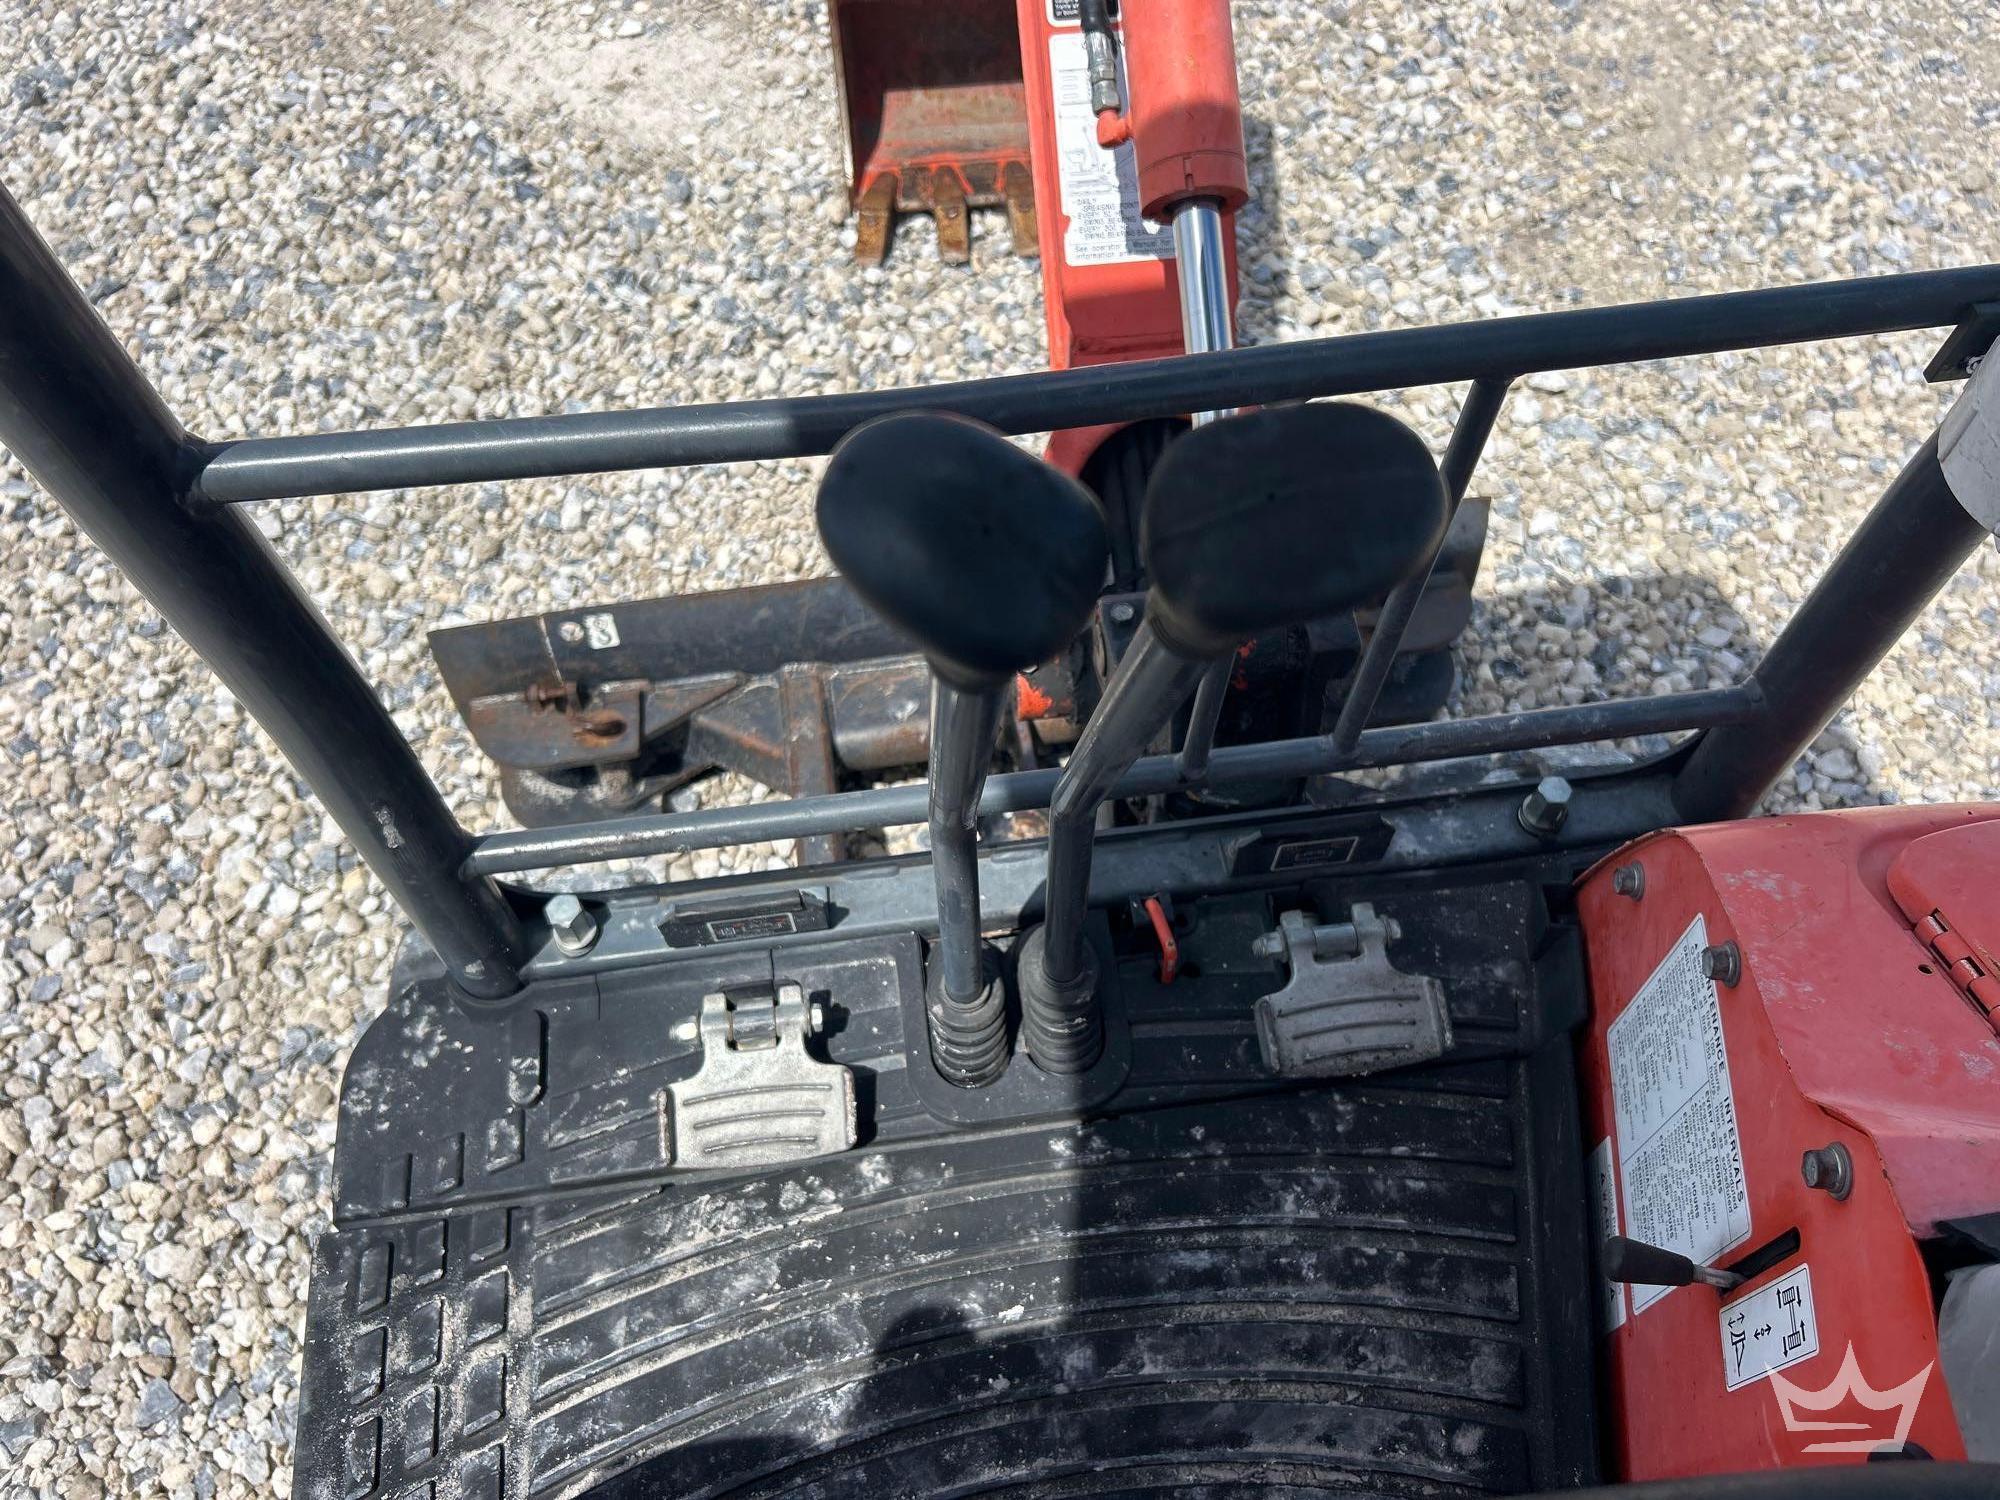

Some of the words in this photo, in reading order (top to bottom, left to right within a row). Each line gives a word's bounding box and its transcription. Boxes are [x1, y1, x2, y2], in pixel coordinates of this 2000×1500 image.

[1688, 977, 1696, 1013] CHECK
[1692, 954, 1700, 994] Service
[1720, 1155, 1733, 1214] scheduled
[1696, 949, 1705, 989] Service
[1725, 1151, 1738, 1210] scheduled
[1705, 976, 1725, 1073] NTENANCE
[1722, 1095, 1744, 1203] INTERVALS
[1704, 1089, 1713, 1125] EVERY
[1713, 1155, 1723, 1195] HOURS
[1666, 1201, 1674, 1239] HOURS
[1691, 1180, 1699, 1219] HOURS
